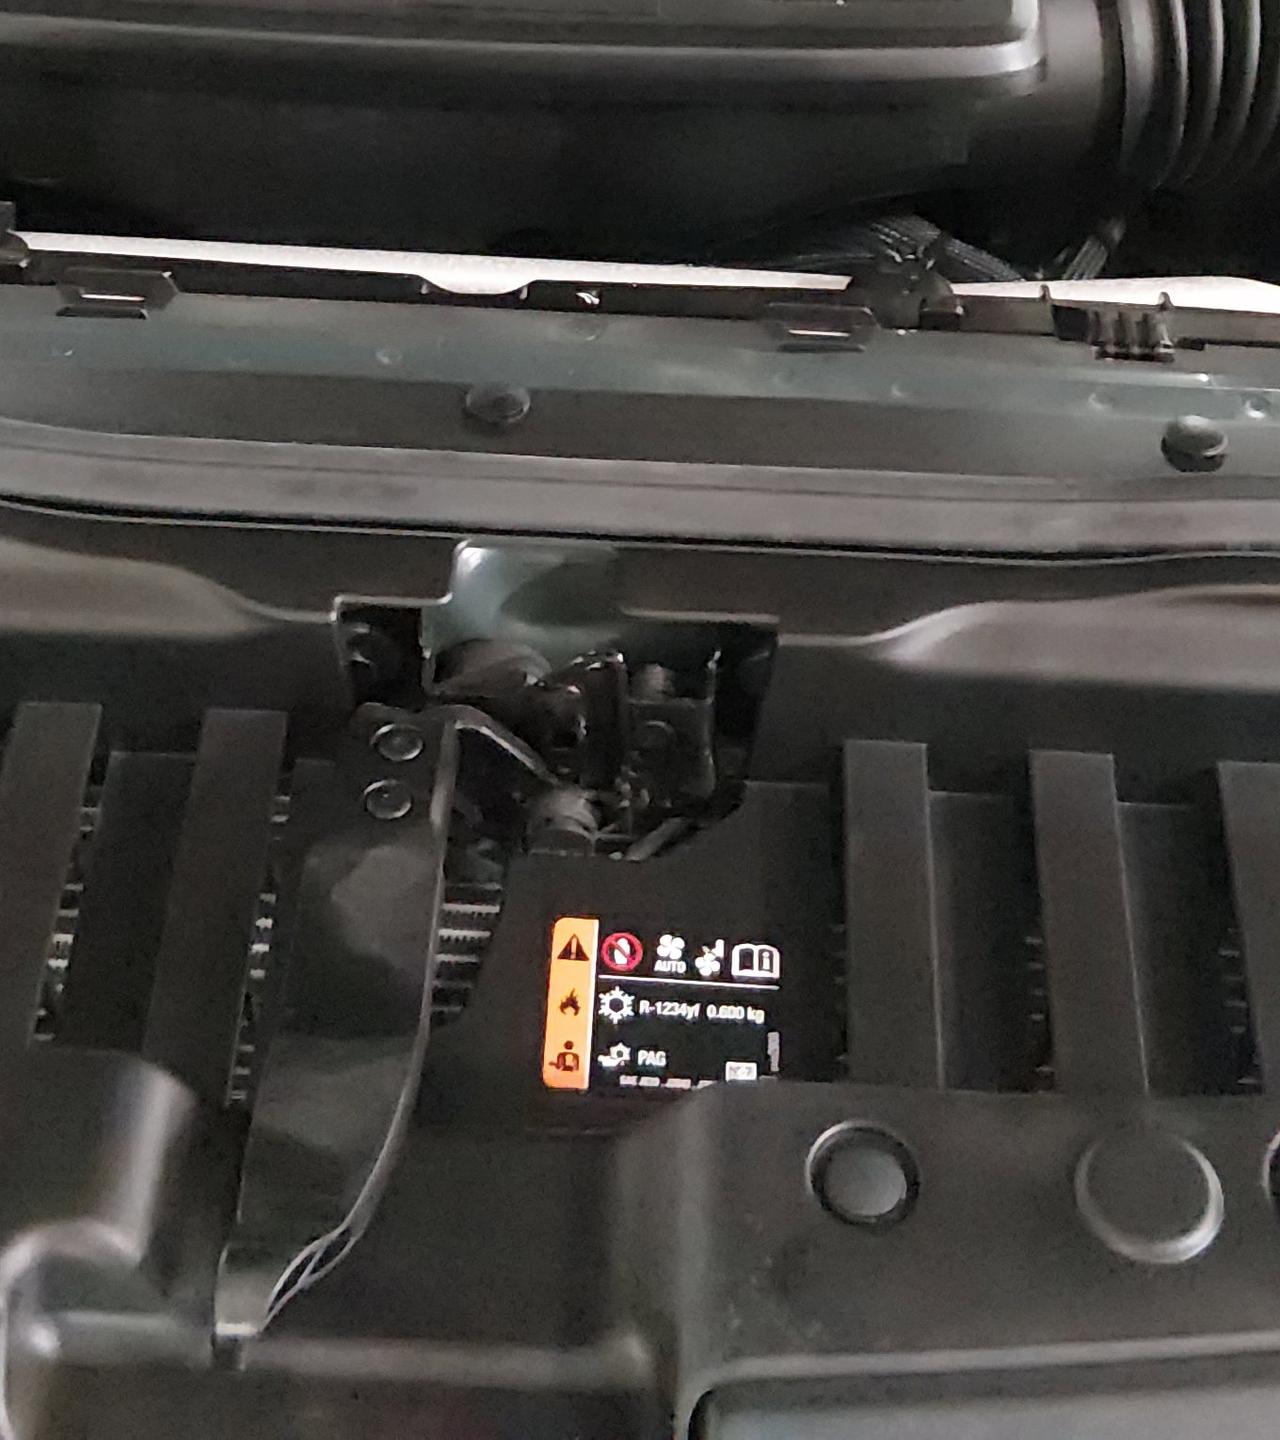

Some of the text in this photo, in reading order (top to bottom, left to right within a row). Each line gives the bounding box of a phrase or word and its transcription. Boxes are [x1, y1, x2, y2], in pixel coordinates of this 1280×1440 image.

[653, 959, 687, 974] AUTO
[639, 1000, 700, 1019] R-1234yf
[747, 1006, 765, 1024] kg
[637, 1050, 667, 1066] PAG
